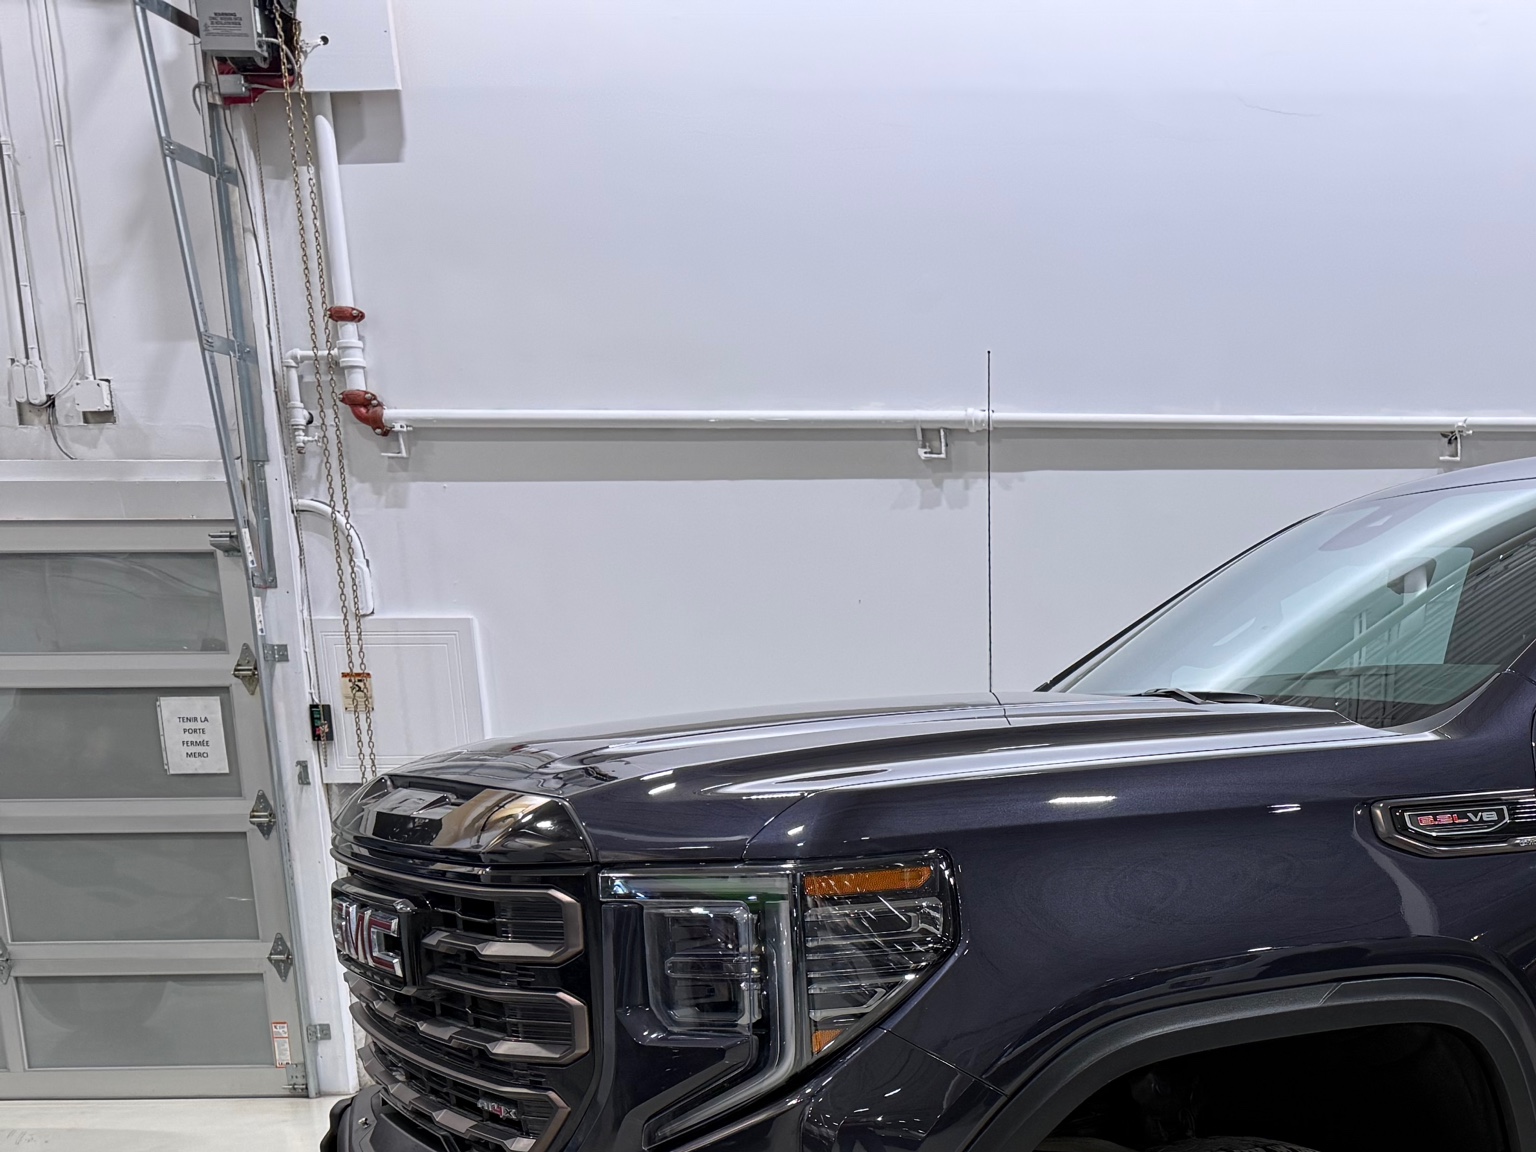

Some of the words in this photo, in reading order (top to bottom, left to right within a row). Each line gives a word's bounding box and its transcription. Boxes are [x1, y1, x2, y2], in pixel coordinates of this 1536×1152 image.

[182, 739, 210, 747] FERMÉE
[1467, 811, 1498, 822] V8
[476, 1099, 517, 1119] AT4X
